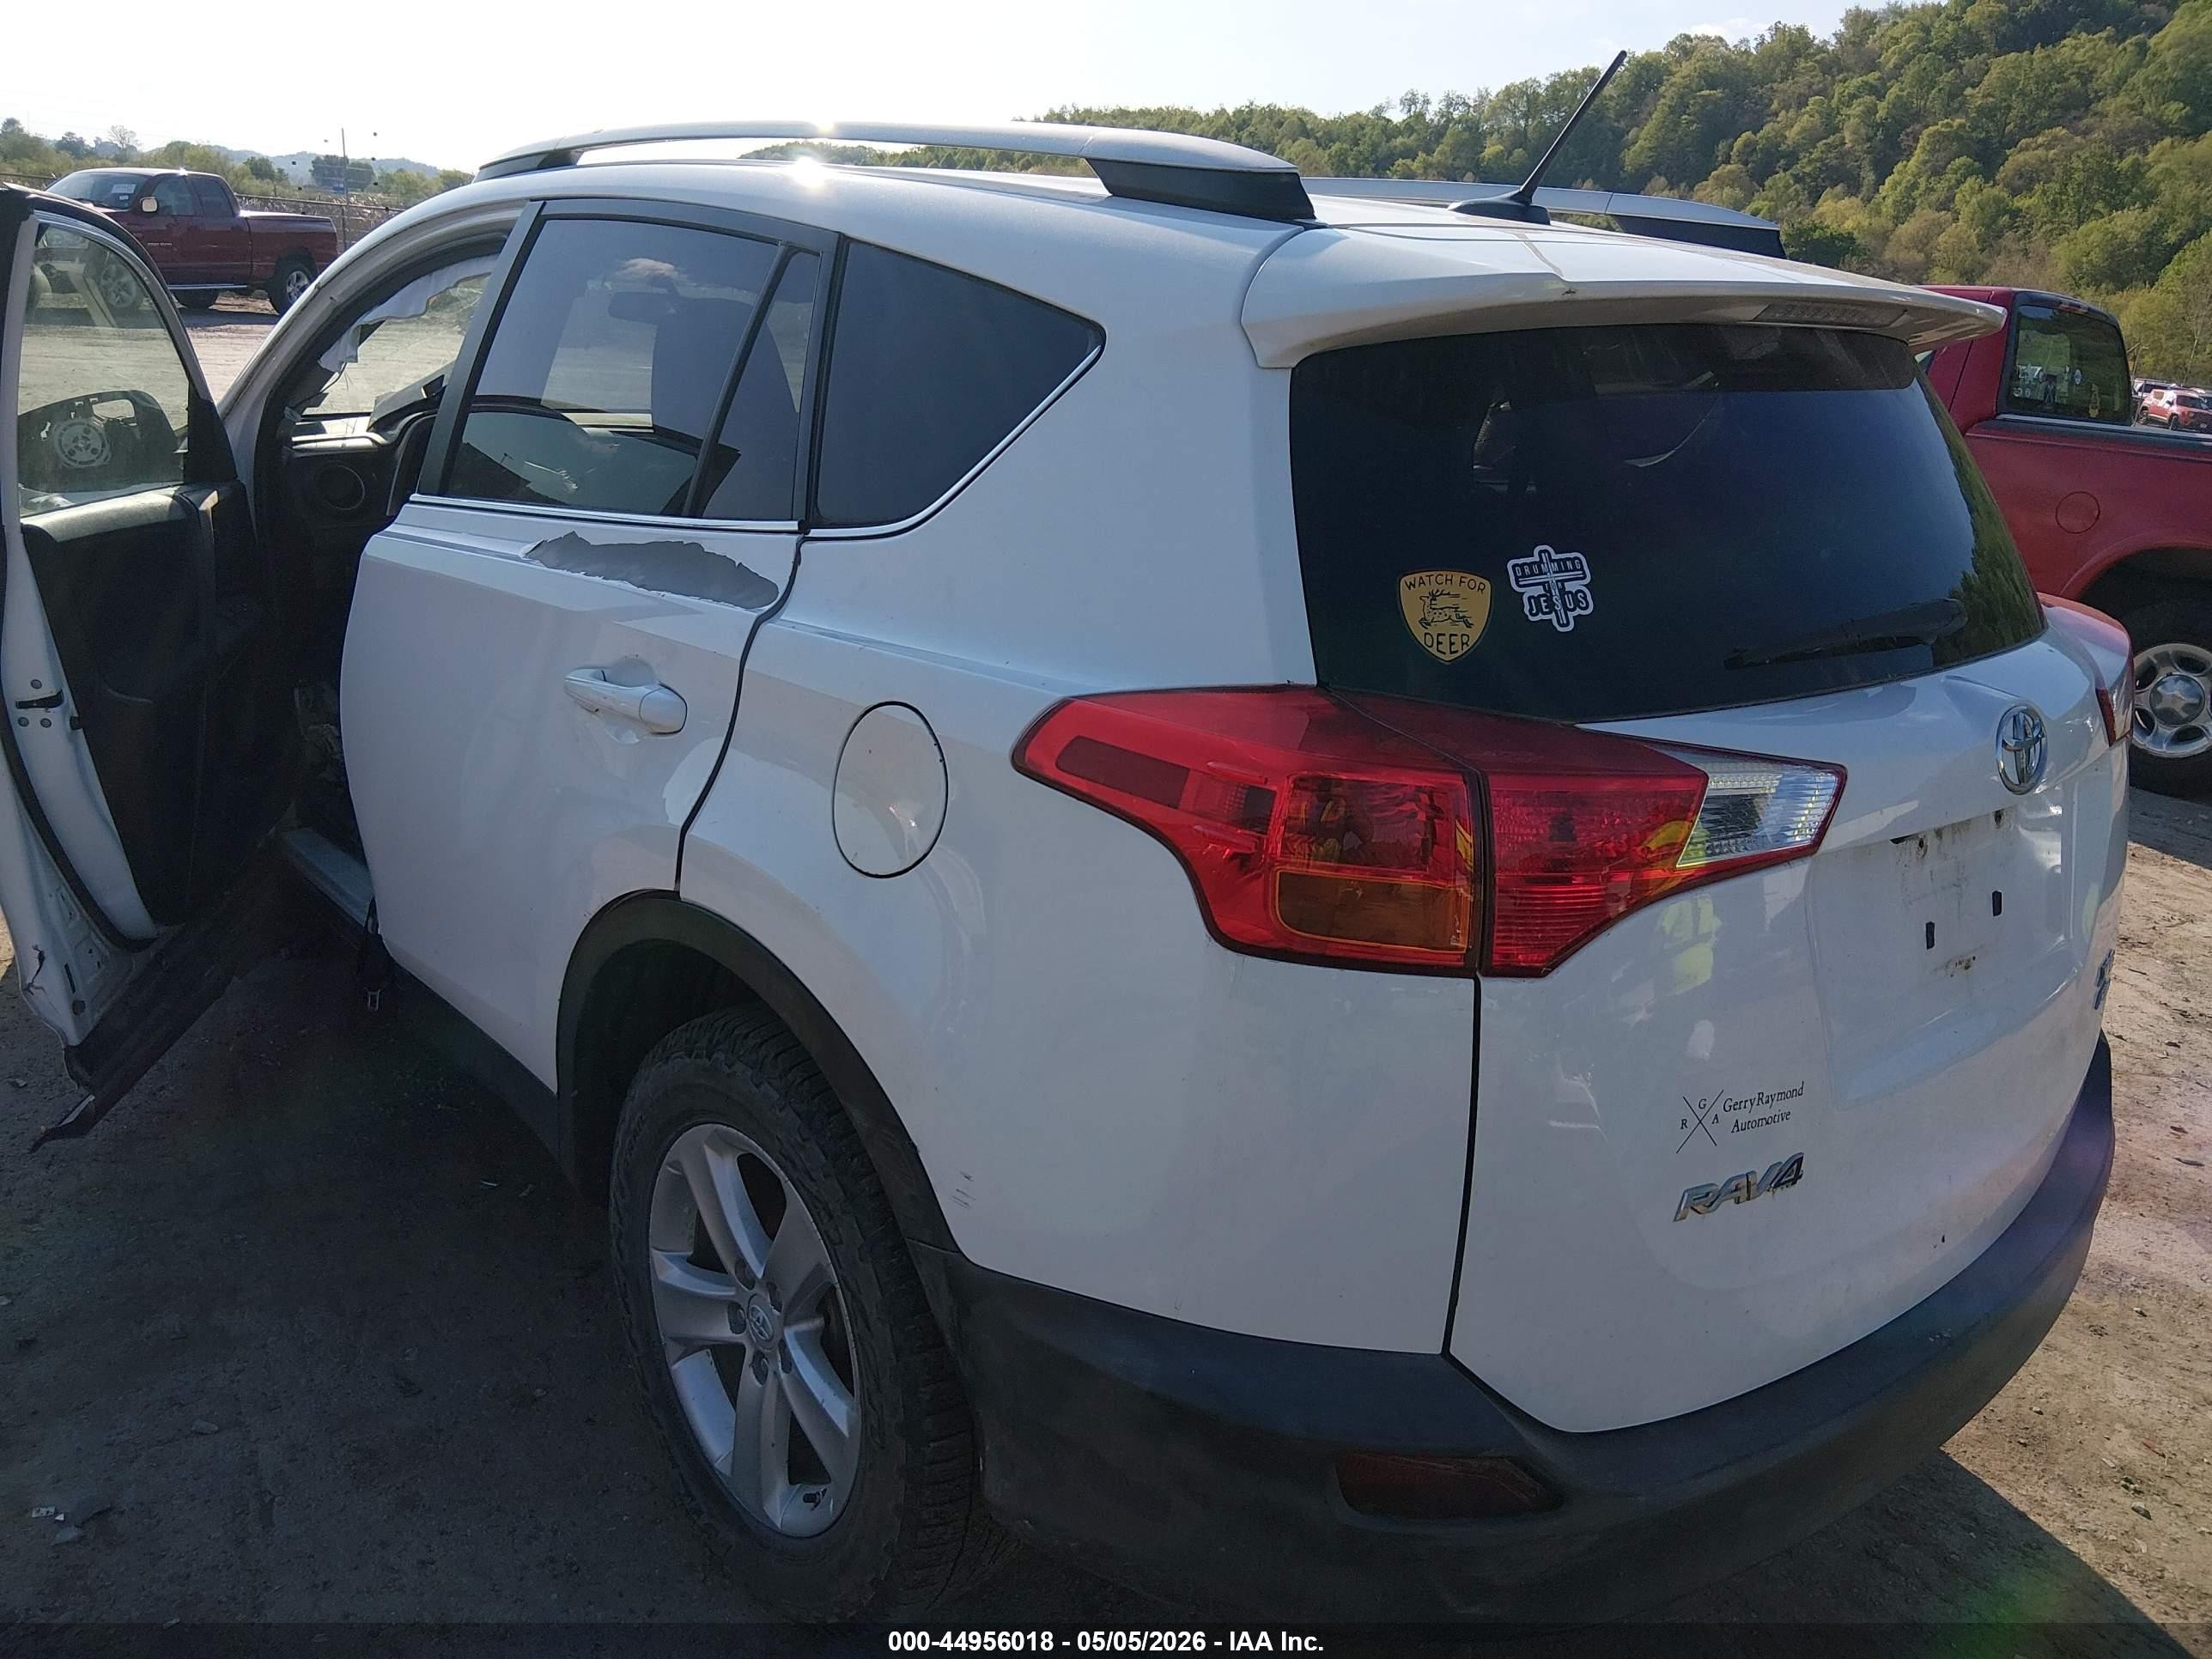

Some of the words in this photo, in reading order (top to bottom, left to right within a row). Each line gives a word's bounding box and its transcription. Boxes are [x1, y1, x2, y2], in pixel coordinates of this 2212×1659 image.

[1515, 559, 1581, 577] DRUMMING
[1404, 574, 1454, 591] WATCH
[1459, 575, 1486, 594] FOR
[1530, 592, 1587, 614] JESUS
[1424, 632, 1470, 655] DEER
[1731, 1109, 1791, 1133] Automotive
[1674, 1152, 1805, 1223] RAV4
